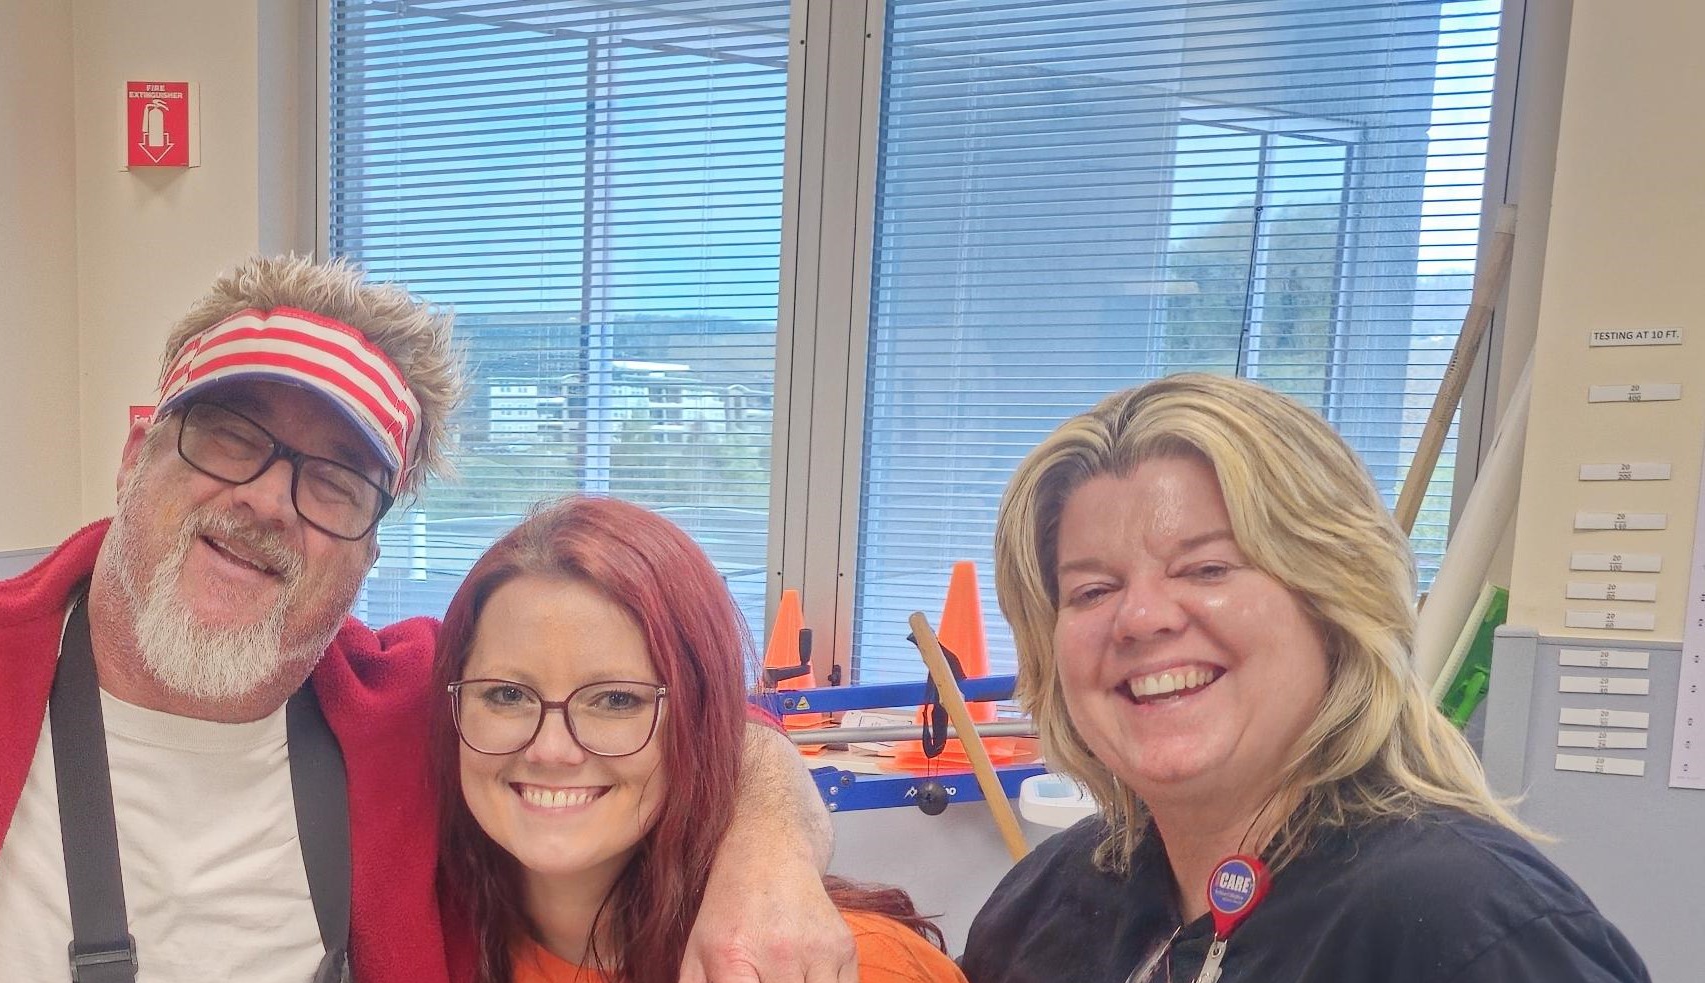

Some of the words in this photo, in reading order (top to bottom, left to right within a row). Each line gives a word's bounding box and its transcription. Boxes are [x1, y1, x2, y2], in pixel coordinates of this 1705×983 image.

[128, 91, 183, 99] EXTINGUISHER
[1594, 331, 1633, 340] TESTING
[1636, 331, 1649, 339] AT
[1652, 330, 1663, 339] 10
[1665, 330, 1680, 339] FT.
[1630, 384, 1640, 392] 20
